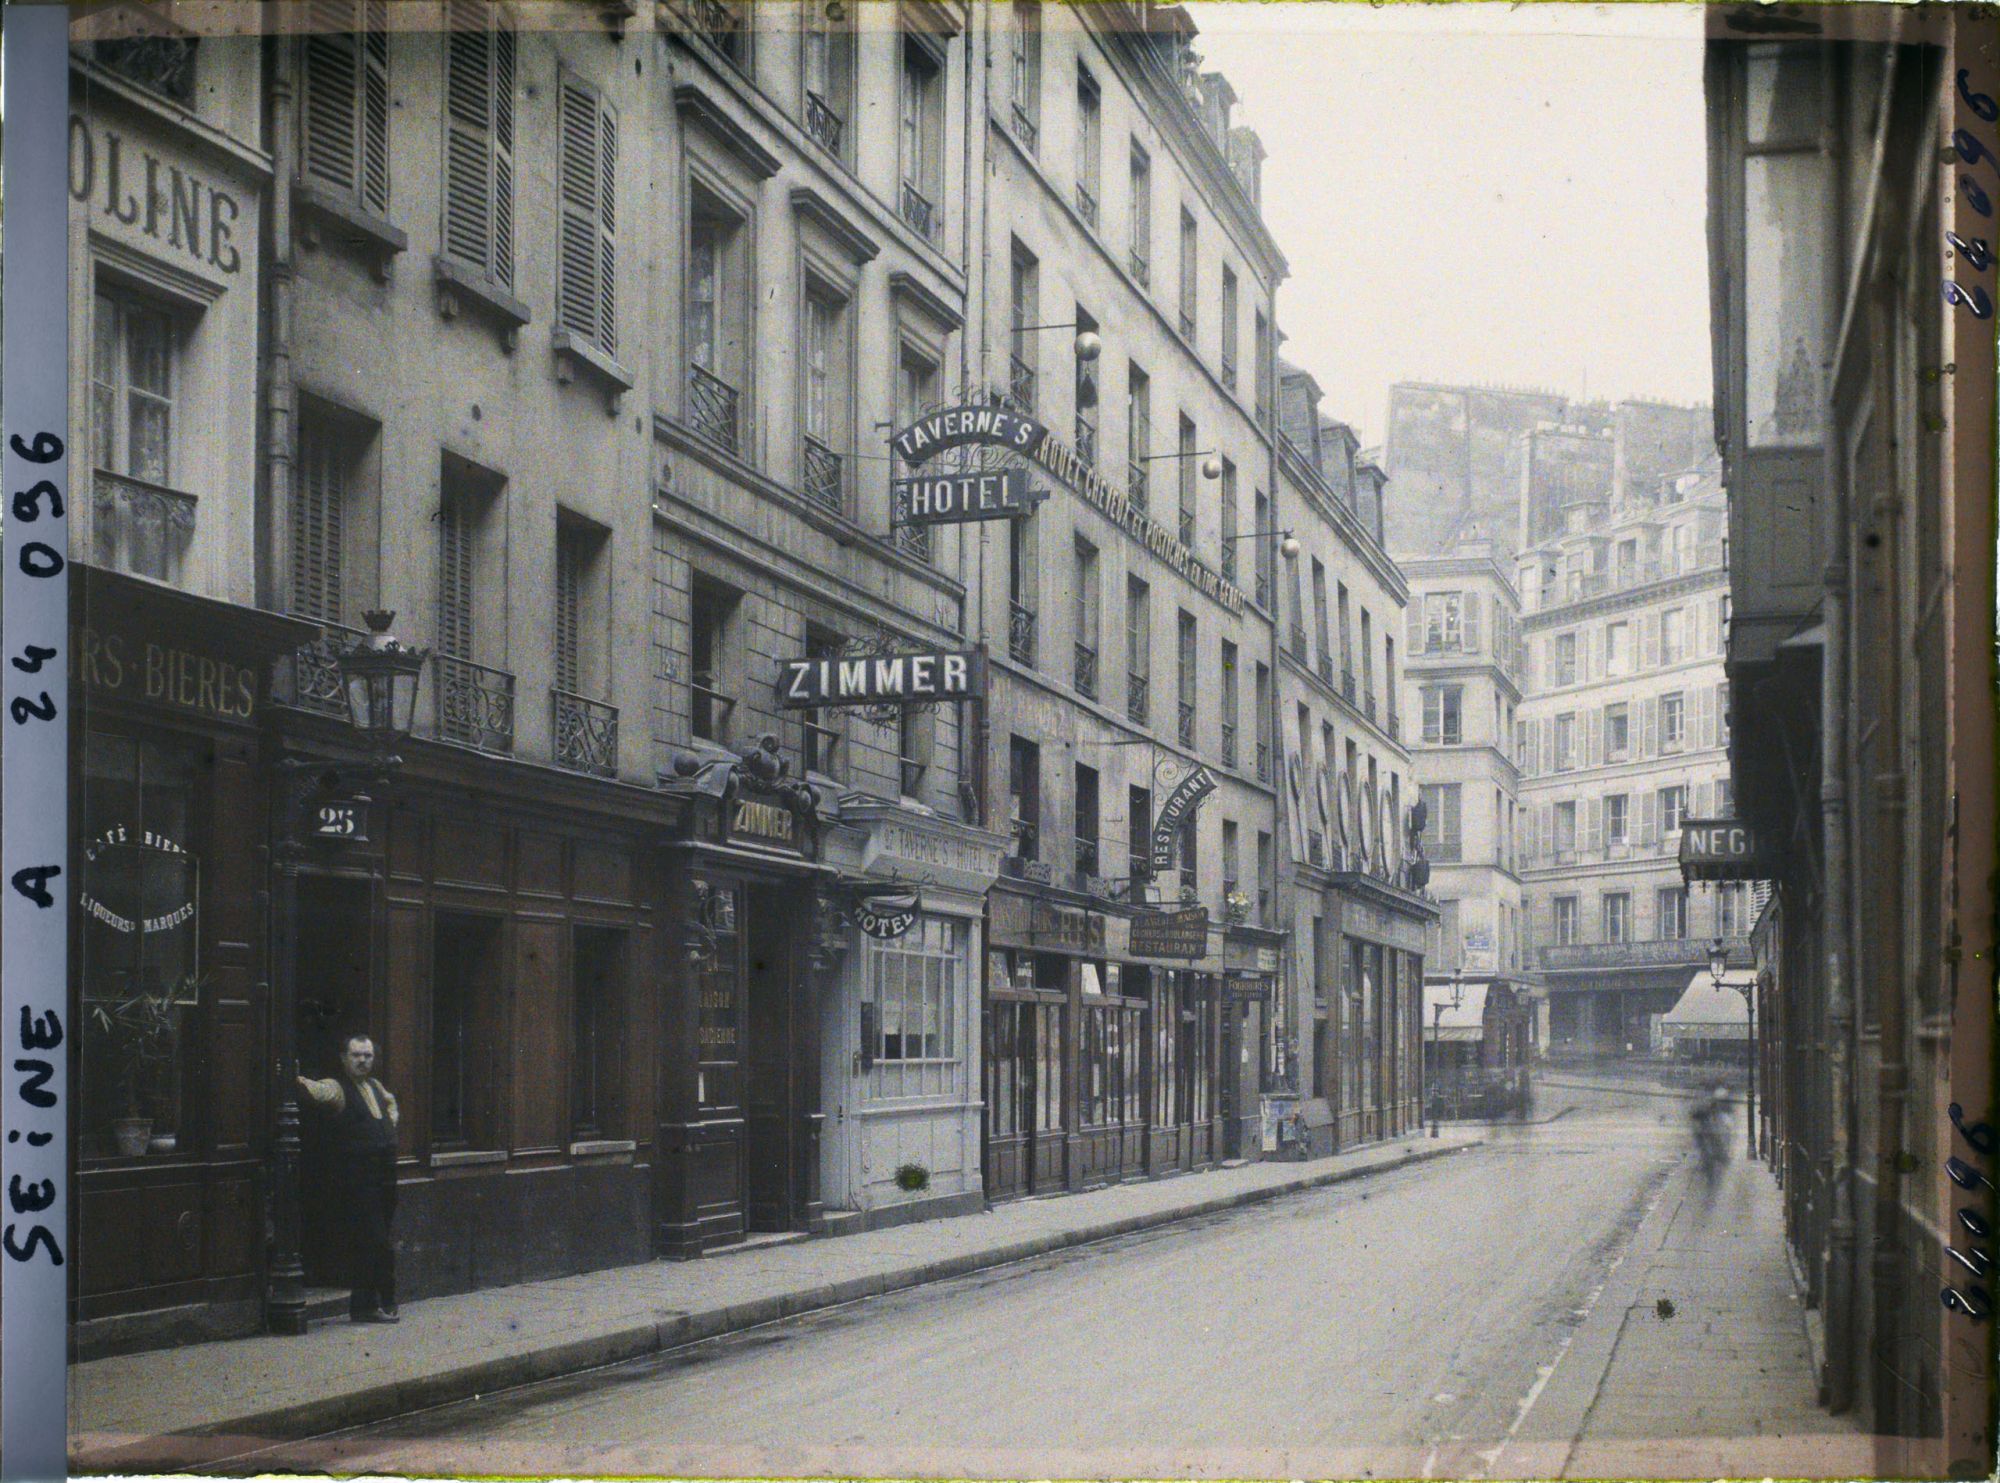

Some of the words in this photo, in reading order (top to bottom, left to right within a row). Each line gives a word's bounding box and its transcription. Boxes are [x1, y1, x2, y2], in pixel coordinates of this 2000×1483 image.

[897, 410, 1033, 455] TAVERNE'S
[911, 475, 1020, 516] HOTEL
[1144, 519, 1191, 575] POSTICHES
[146, 642, 253, 718] BIERES
[788, 654, 967, 699] ZIMMER
[319, 807, 355, 835] 25
[1154, 772, 1207, 865] RESTAURANT
[899, 828, 949, 865] TAVERNE'S
[12, 864, 62, 908] A
[143, 901, 194, 933] MARQUES
[855, 906, 915, 938] HOTEL
